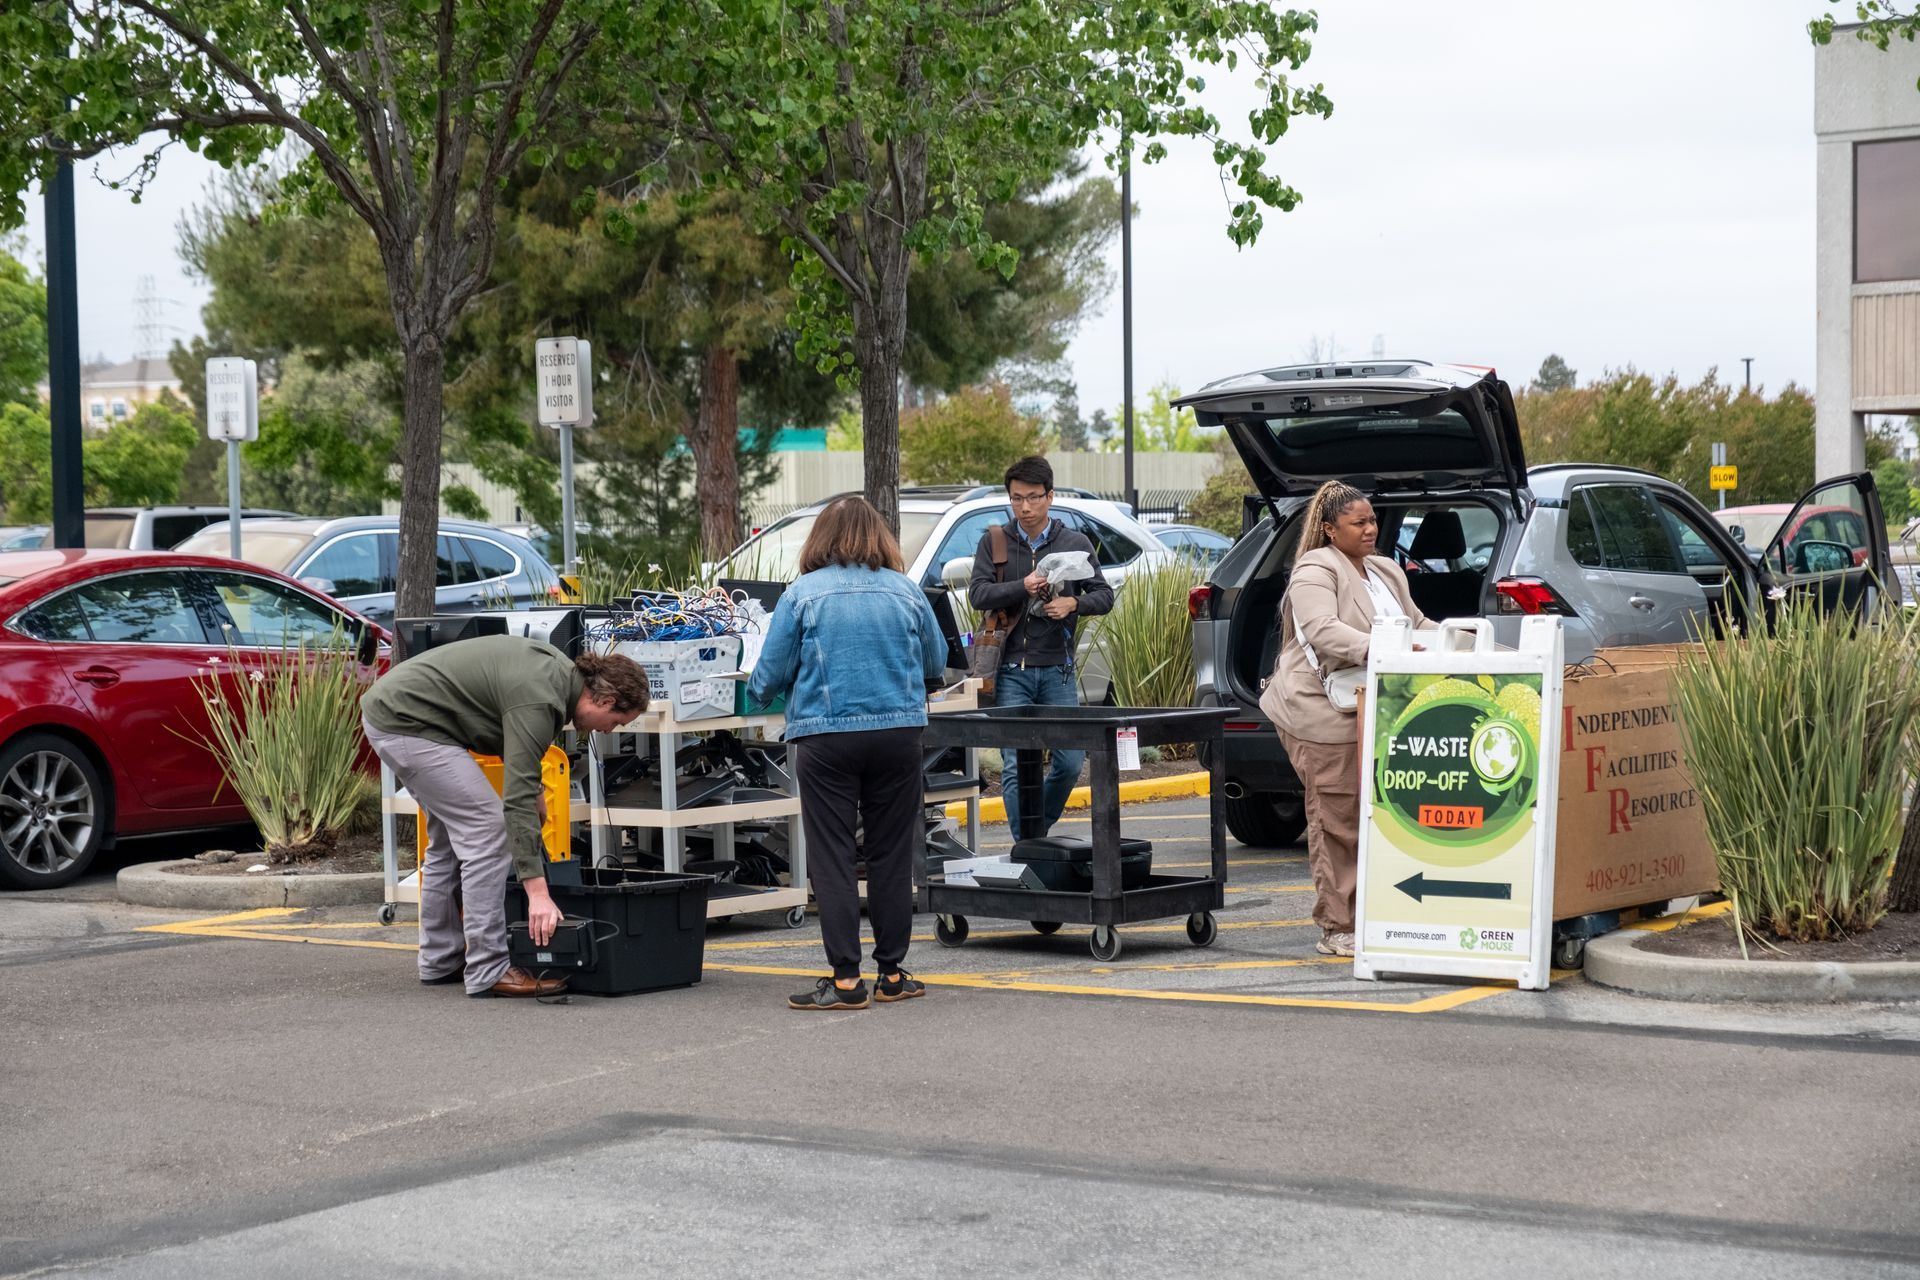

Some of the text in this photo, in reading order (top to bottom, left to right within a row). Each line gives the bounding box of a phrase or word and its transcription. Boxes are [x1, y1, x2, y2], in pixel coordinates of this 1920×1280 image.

[540, 353, 575, 367] RESERVED
[545, 374, 573, 387] 1 HOUR
[545, 394, 574, 408] VISITOR
[1713, 473, 1734, 482] SLOW
[651, 691, 668, 699] VICE
[1388, 736, 1469, 757] E-WASTE
[1584, 746, 1678, 793] FACILITIES
[1384, 769, 1469, 791] DROP-OFF
[1424, 809, 1476, 825] TODAY
[1607, 788, 1697, 836] RESOURCE
[1585, 854, 1686, 893] 408-921-3500
[1385, 929, 1447, 941] greenmouse.com
[1480, 930, 1515, 941] GREEN
[1480, 941, 1514, 952] MOUSE
